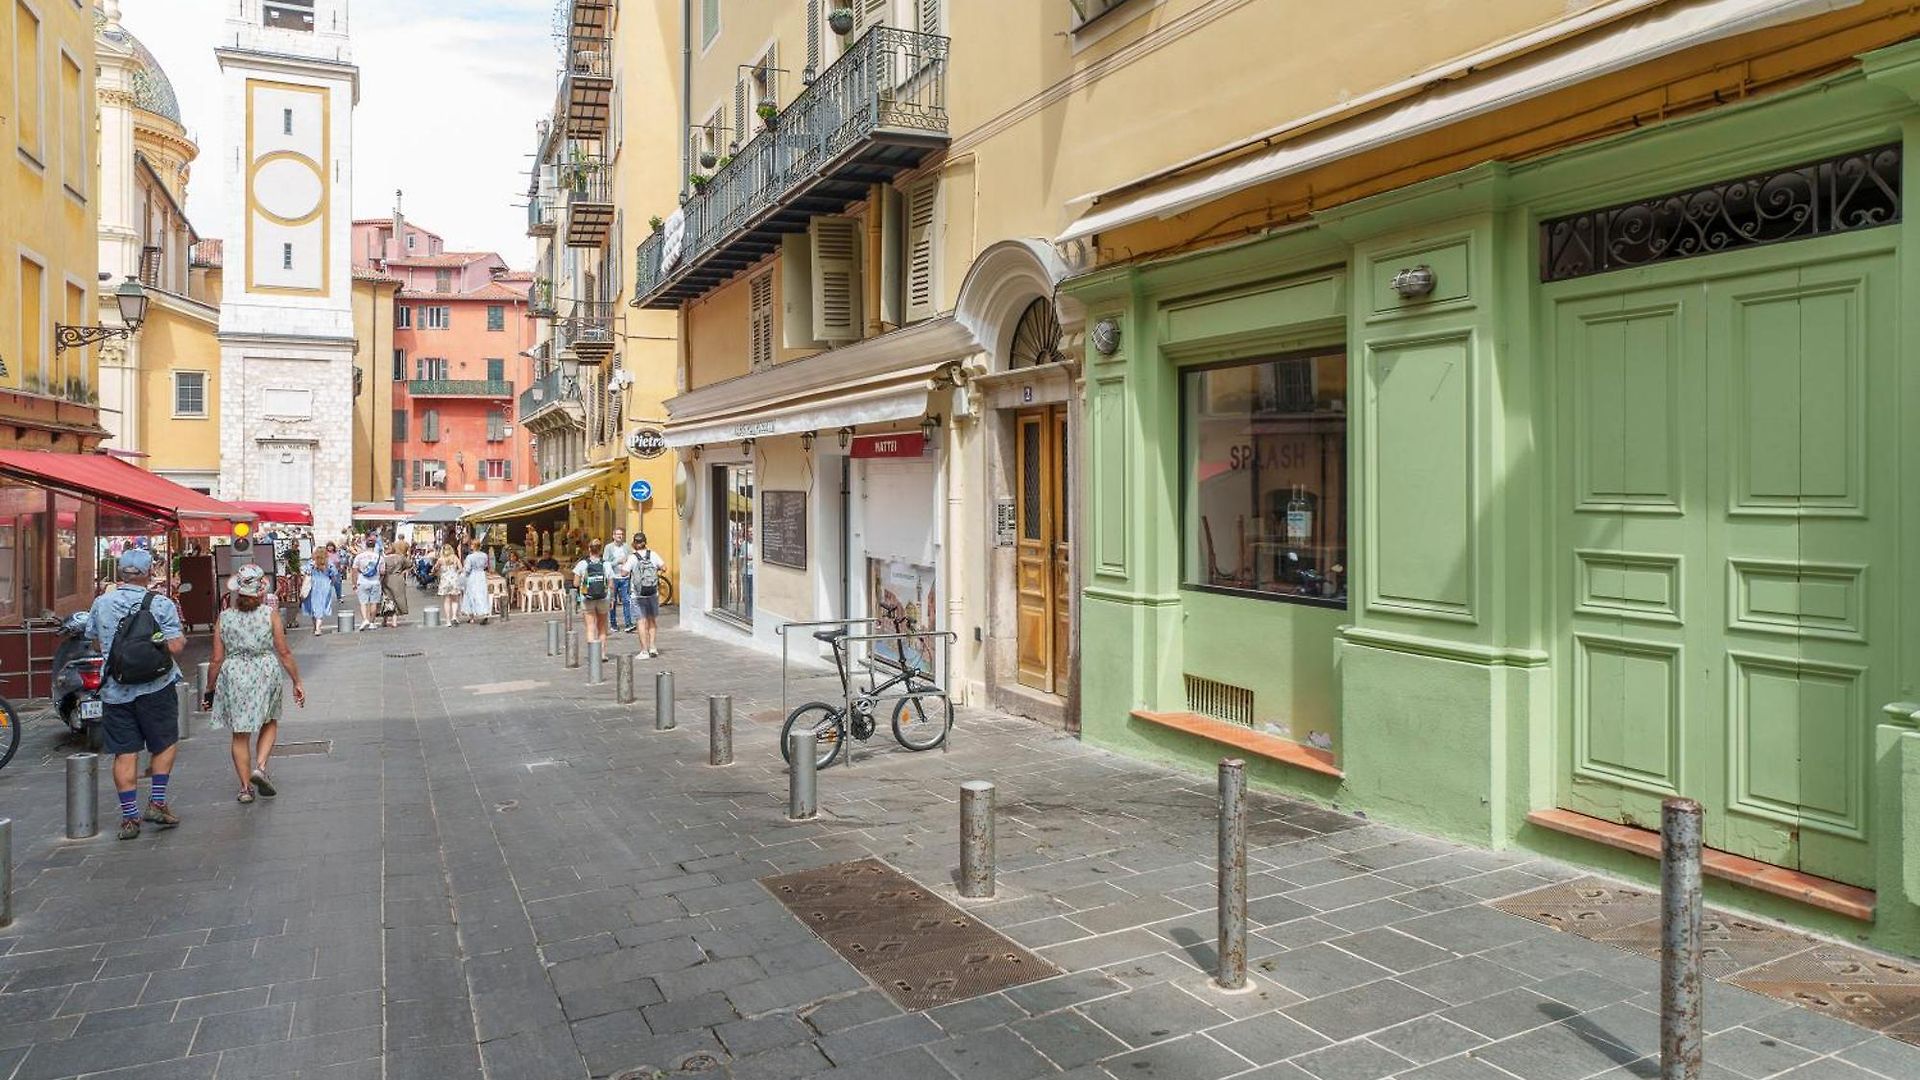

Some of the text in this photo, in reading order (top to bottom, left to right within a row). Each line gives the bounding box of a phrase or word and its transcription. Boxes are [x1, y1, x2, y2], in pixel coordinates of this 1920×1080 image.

[629, 434, 664, 448] Pietra
[874, 440, 897, 453] MATTEI
[1230, 442, 1305, 470] SPLASH
